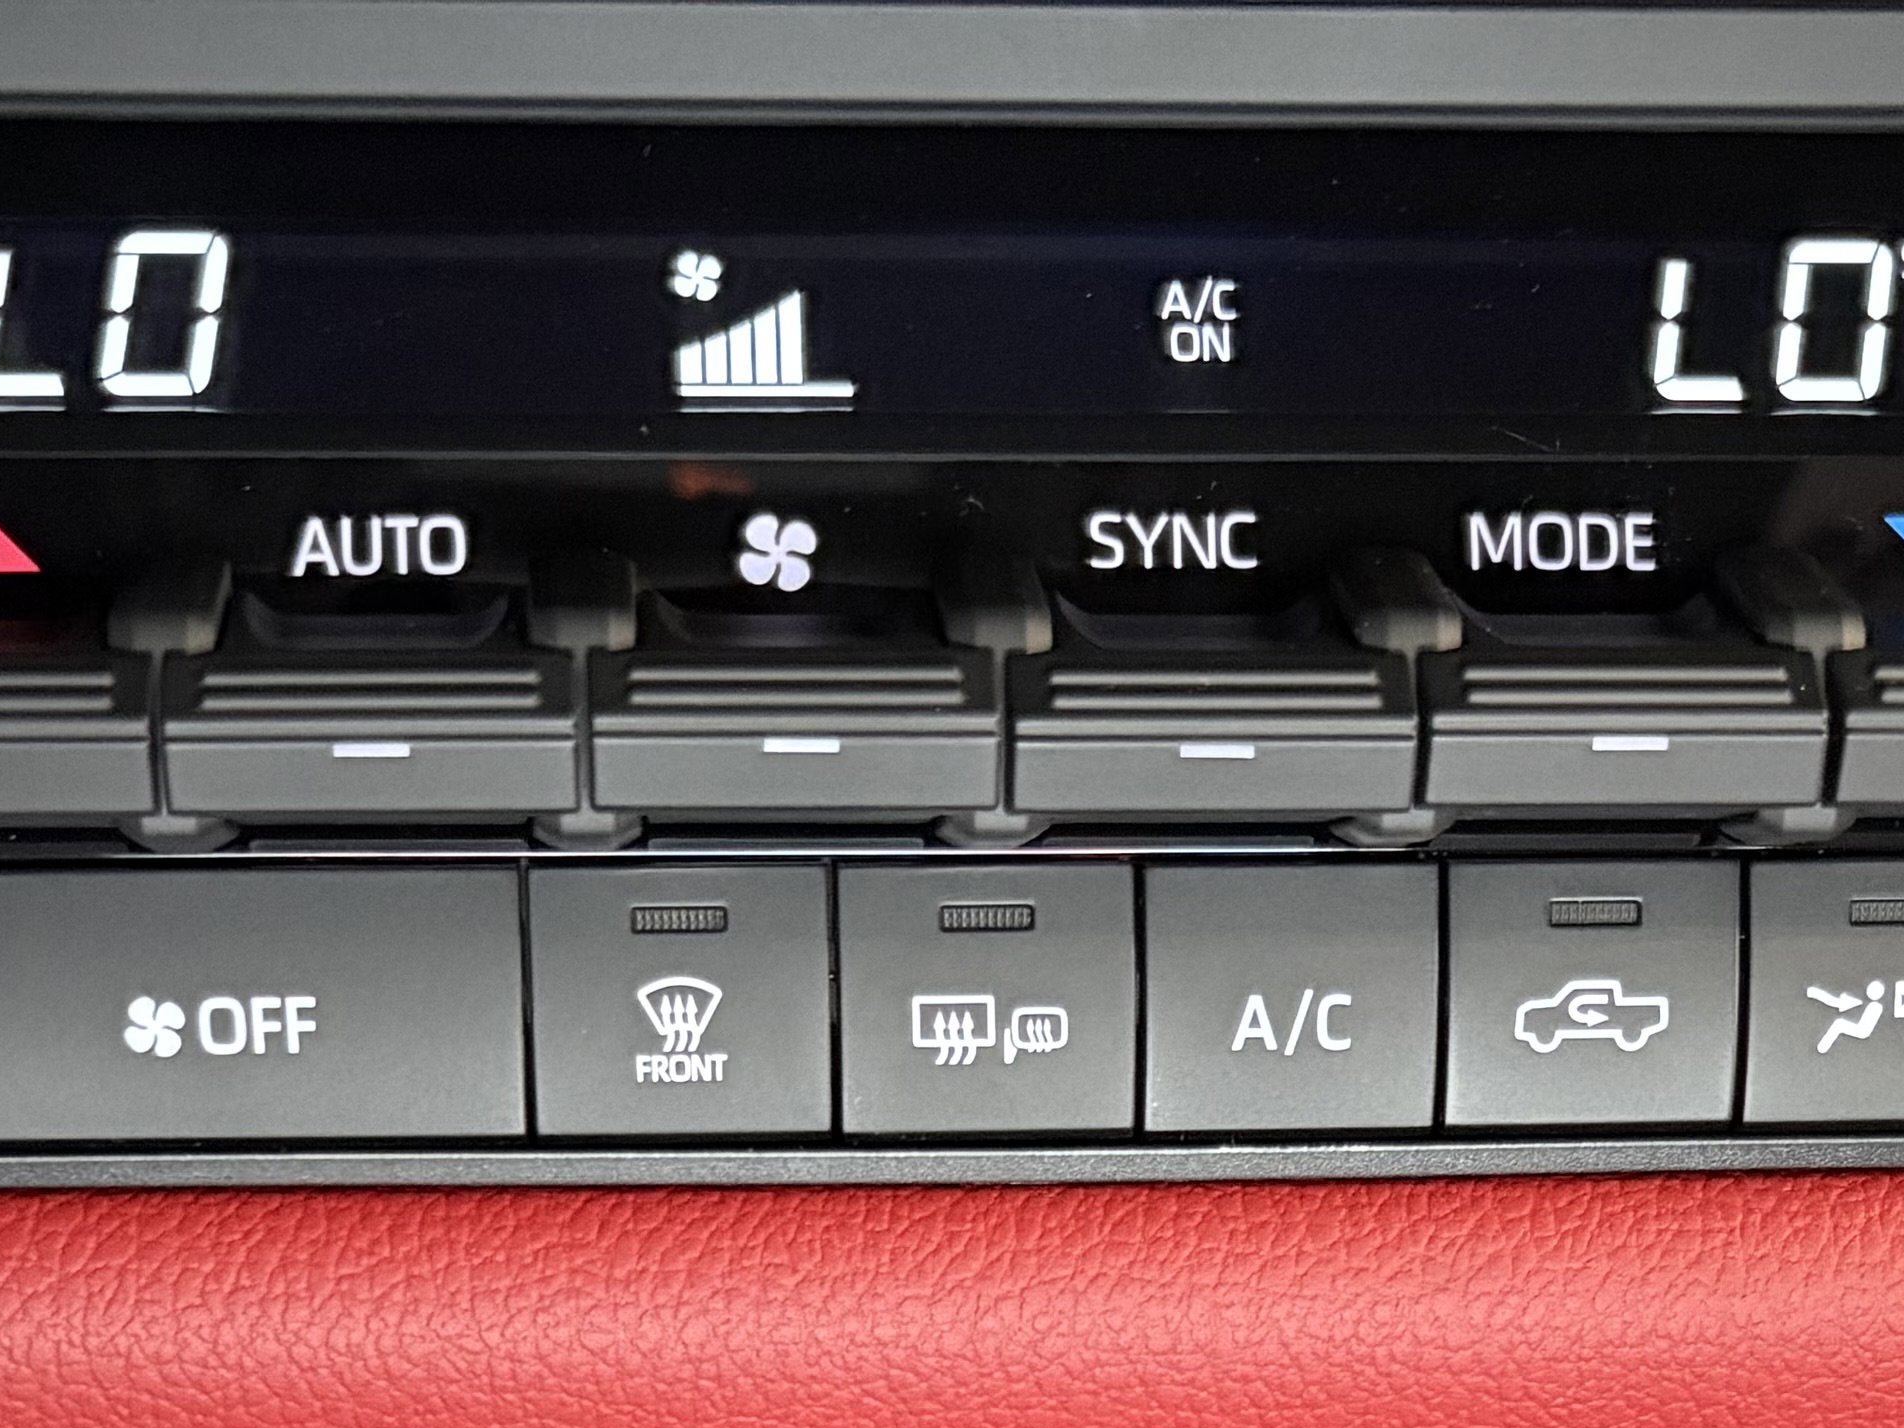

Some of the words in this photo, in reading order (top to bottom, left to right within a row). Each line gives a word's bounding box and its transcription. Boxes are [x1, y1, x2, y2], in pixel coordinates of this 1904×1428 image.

[1159, 274, 1239, 325] A/C
[1650, 237, 1895, 403] LO
[1168, 322, 1233, 364] ON
[290, 512, 469, 578] AUTO
[1086, 510, 1260, 571] SYNC
[1467, 511, 1658, 573] MODE
[197, 994, 319, 1057] OFF
[1229, 986, 1354, 1057] A/C
[634, 1047, 731, 1084] FRONT
